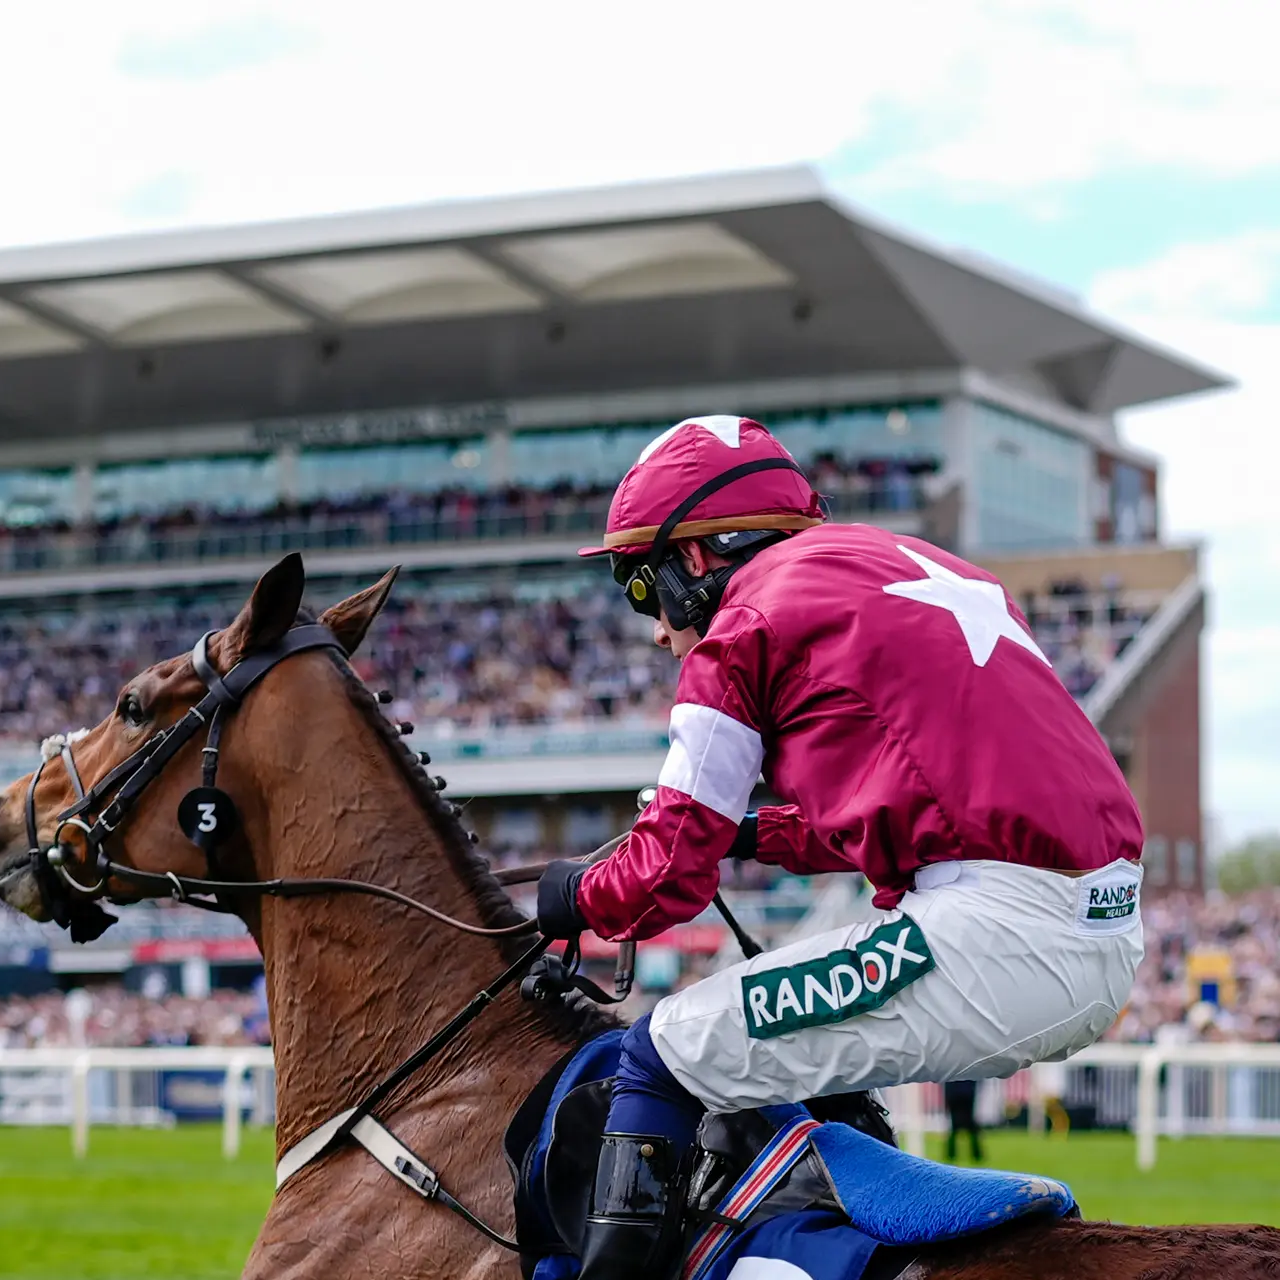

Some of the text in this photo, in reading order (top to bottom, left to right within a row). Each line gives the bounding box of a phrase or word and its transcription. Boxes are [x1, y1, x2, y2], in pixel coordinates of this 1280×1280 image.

[197, 802, 218, 833] 3
[1089, 882, 1138, 905] RANDOX
[749, 926, 927, 1028] RANDOX
